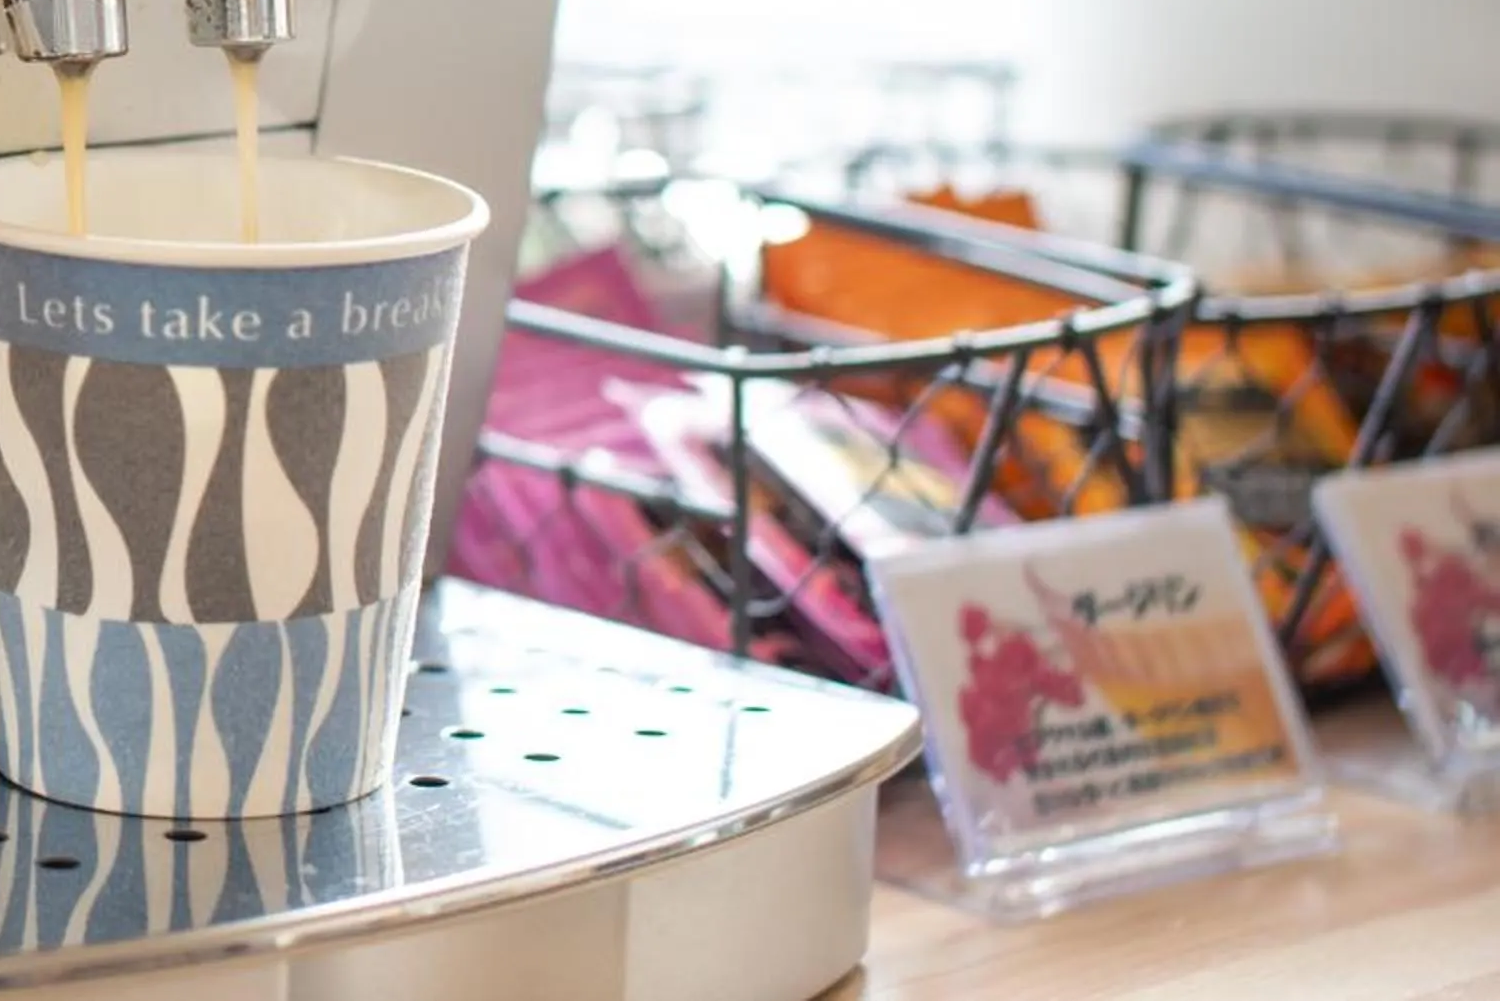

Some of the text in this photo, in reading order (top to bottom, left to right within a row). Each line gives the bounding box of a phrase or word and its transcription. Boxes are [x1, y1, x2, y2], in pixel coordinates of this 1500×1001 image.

[17, 281, 115, 334] Lets
[140, 295, 262, 341] take
[287, 308, 312, 339] a
